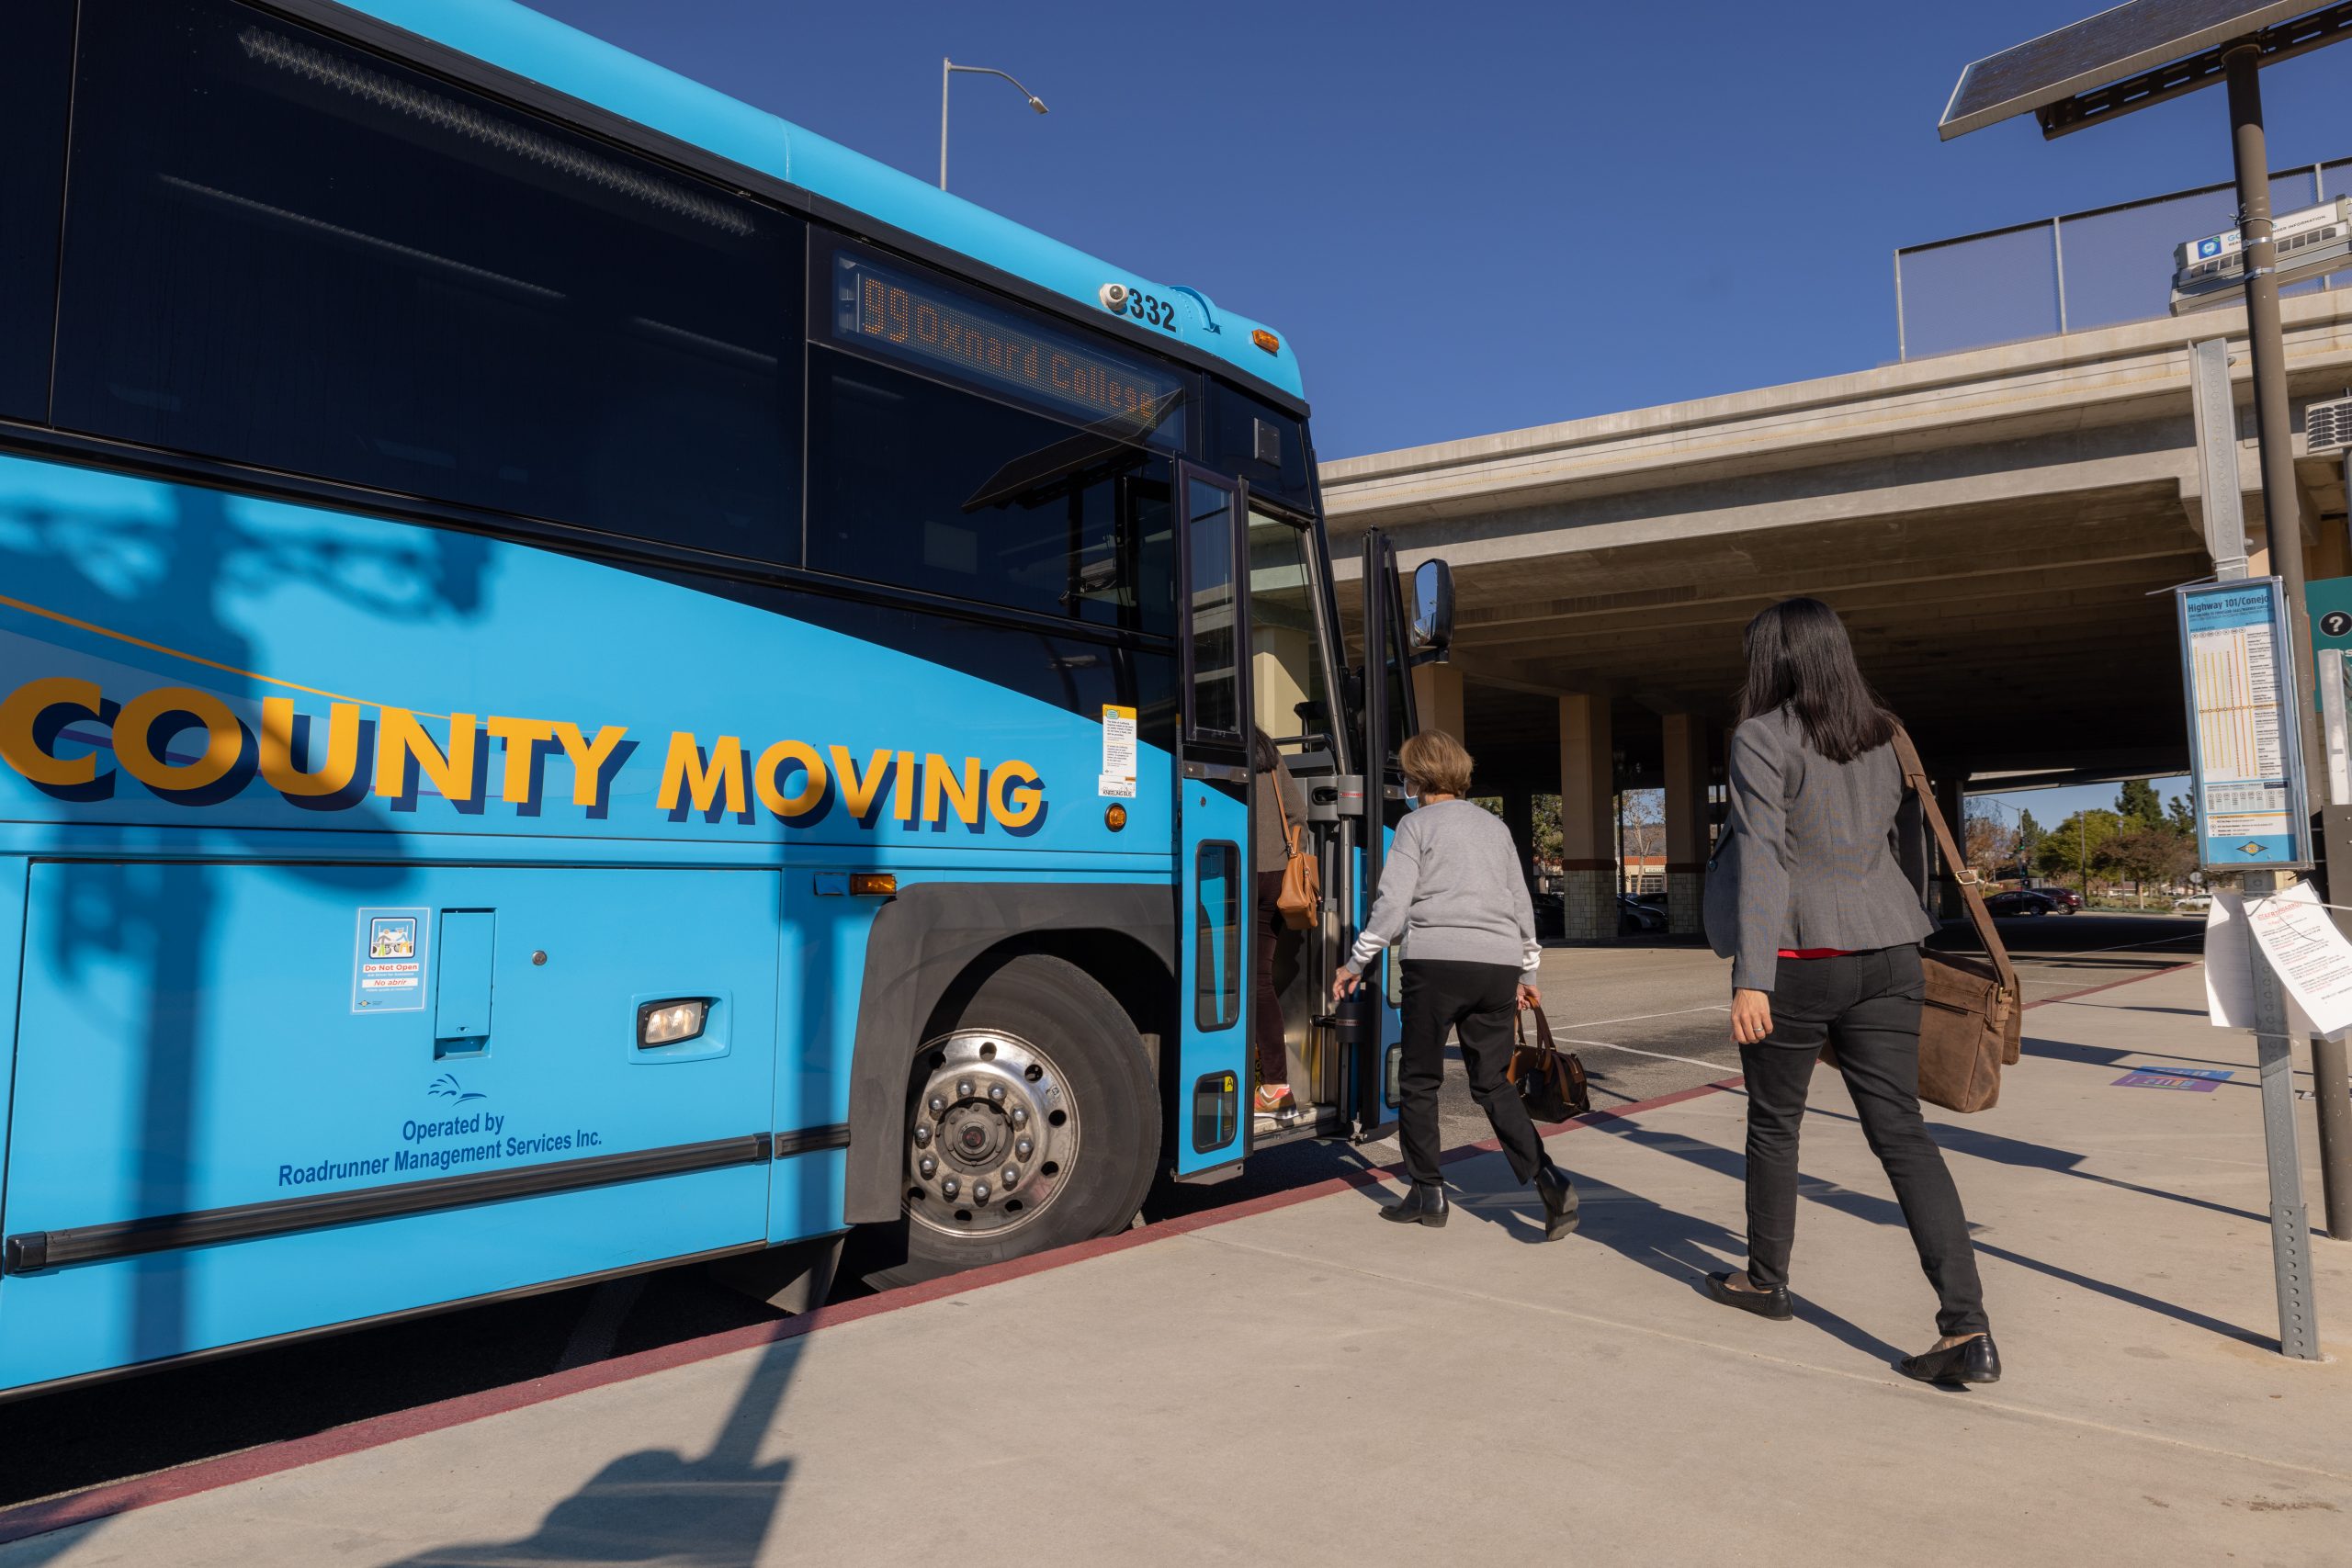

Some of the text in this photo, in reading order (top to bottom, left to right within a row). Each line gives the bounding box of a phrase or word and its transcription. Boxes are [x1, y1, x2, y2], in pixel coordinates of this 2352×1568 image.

[1128, 288, 1177, 333] 332
[916, 303, 1038, 380] Oxnard
[1051, 353, 1156, 420] College
[2188, 601, 2223, 614] Highway
[0, 677, 1046, 834] COUNTY MOVING
[387, 978, 407, 987] abrir
[396, 964, 418, 973] Open
[402, 1111, 505, 1145] Operated by
[278, 1128, 603, 1188] Roadrunner Management Services Inc.
